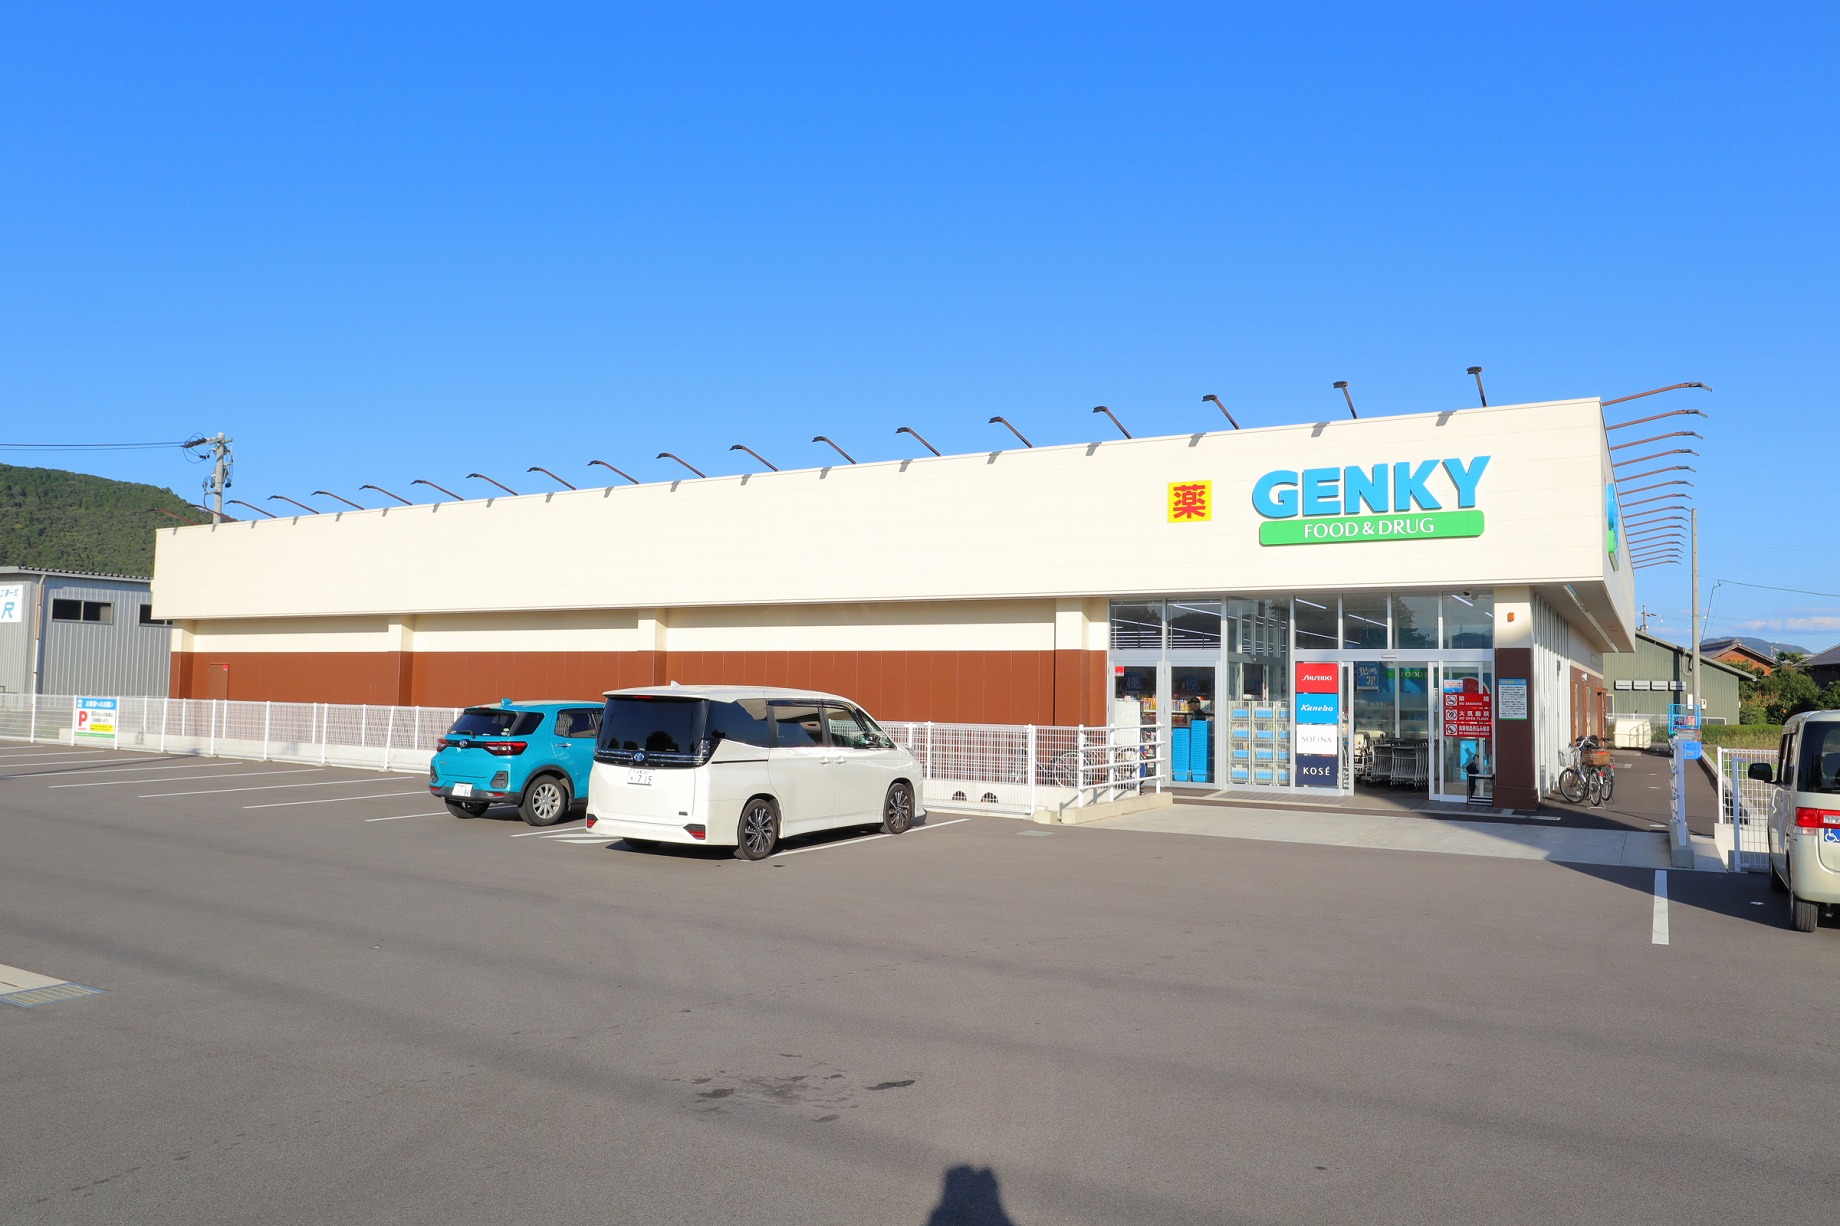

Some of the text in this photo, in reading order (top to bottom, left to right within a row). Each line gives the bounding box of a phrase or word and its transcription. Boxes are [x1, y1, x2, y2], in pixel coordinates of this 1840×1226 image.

[1252, 455, 1491, 519] GENKY
[1173, 484, 1206, 519] 薬
[1304, 517, 1435, 539] FOOD & DRUG
[1300, 704, 1334, 712] Kanebo
[78, 710, 88, 727] P
[1301, 736, 1332, 744] SOFINA
[1303, 765, 1330, 776] KOSÉ
